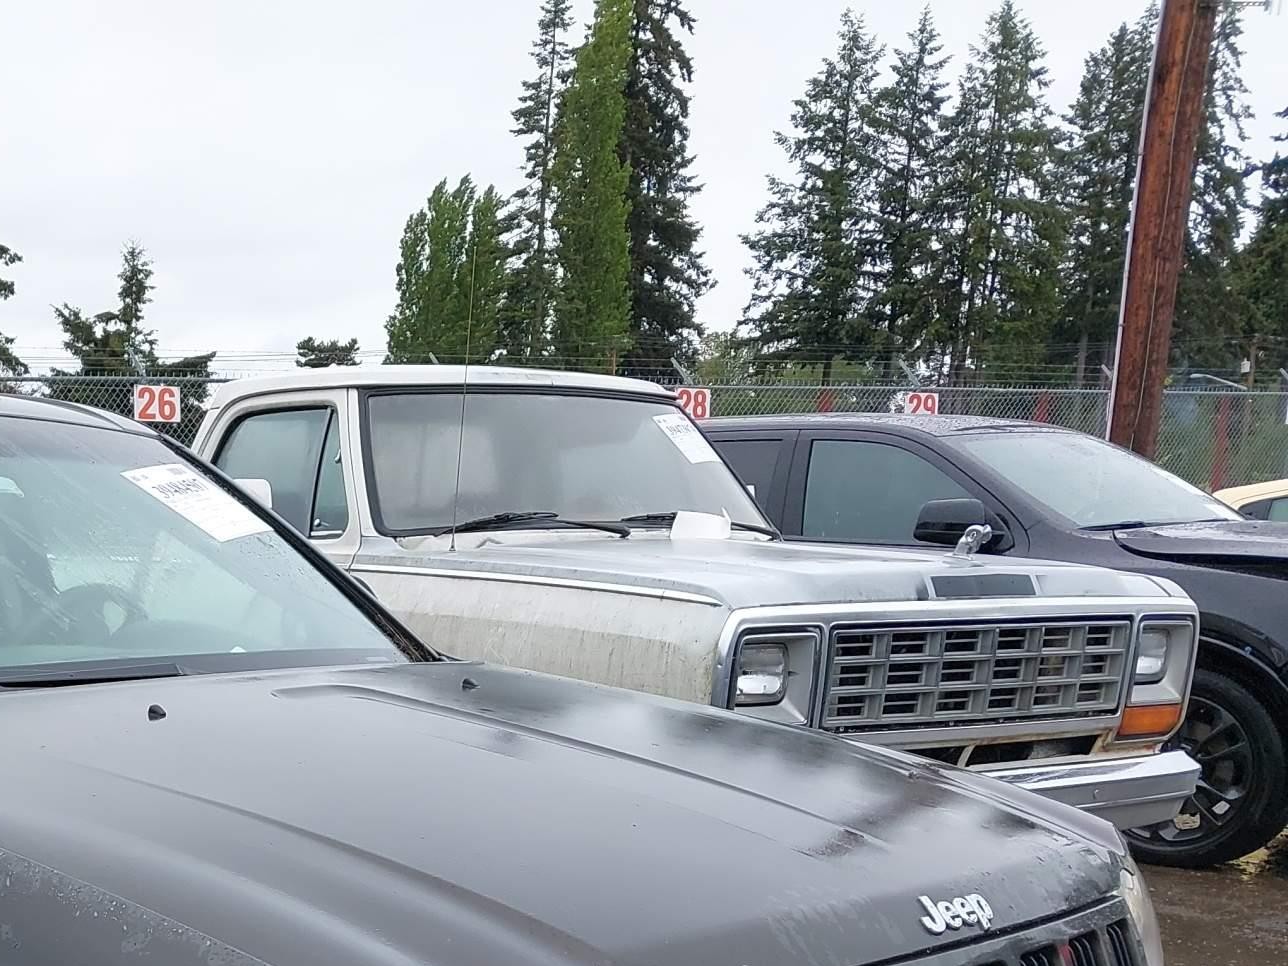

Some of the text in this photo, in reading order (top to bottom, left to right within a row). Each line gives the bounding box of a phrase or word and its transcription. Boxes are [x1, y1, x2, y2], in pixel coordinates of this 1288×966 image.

[138, 387, 177, 420] 26
[678, 389, 707, 418] 28
[909, 394, 936, 415] 29
[917, 893, 994, 934] Jeep
